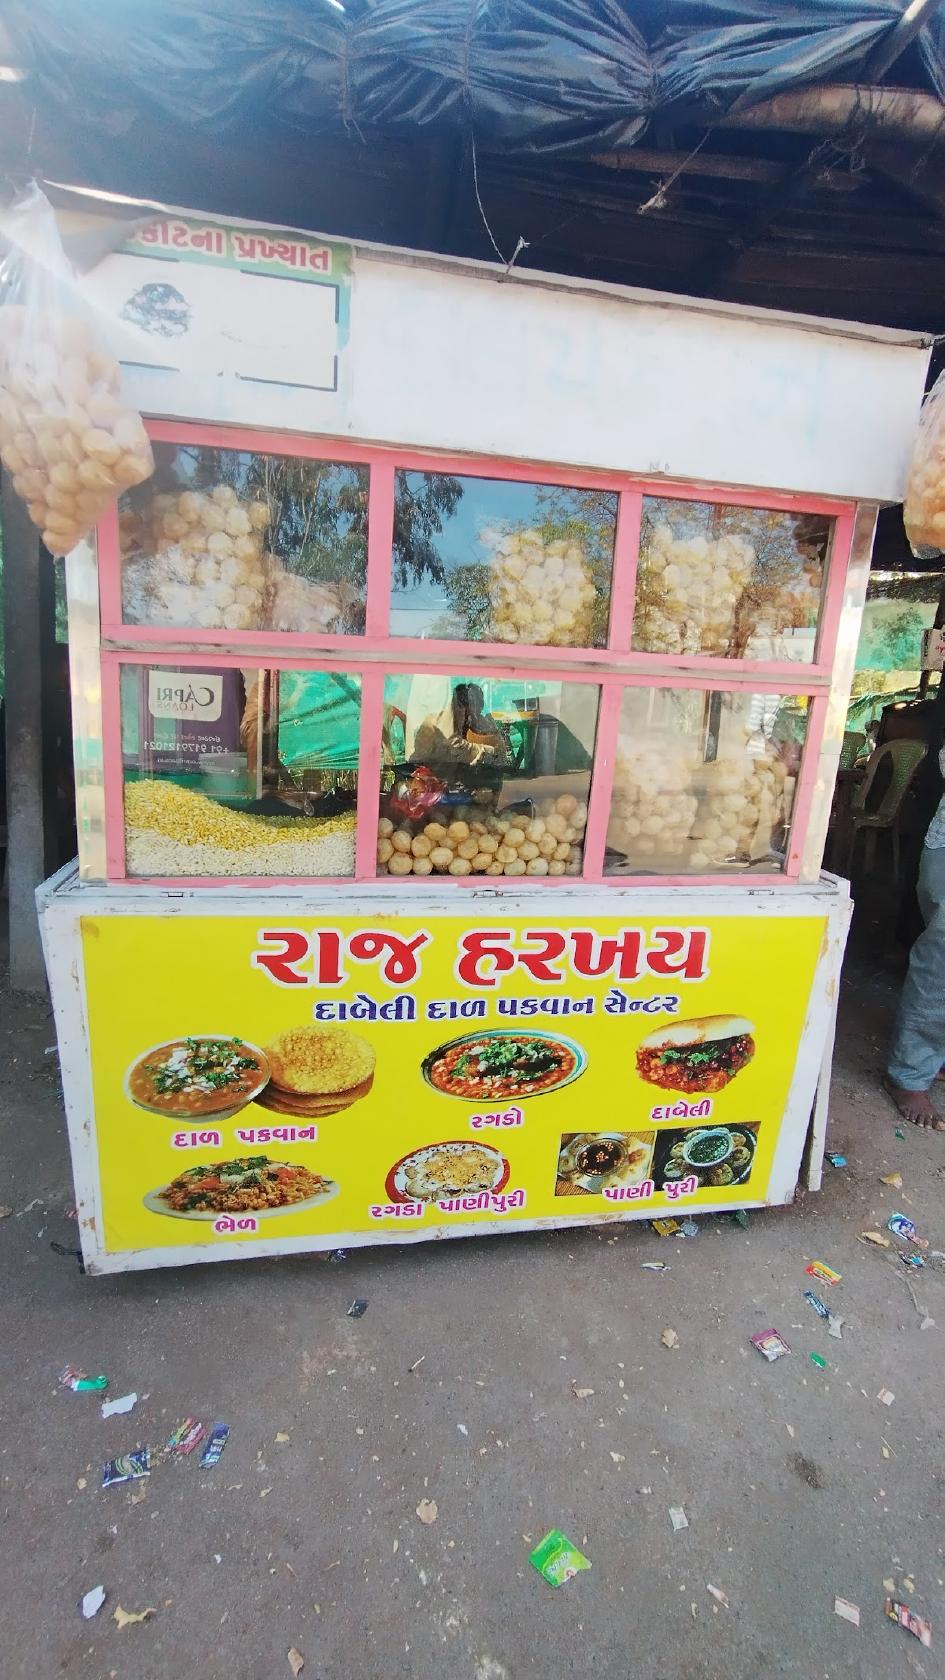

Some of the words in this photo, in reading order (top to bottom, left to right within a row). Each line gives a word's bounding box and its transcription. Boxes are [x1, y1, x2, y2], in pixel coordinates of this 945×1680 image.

[235, 235, 329, 271] પ્રખ્યાત
[256, 932, 429, 984] રાજ
[458, 931, 706, 986] હરખય
[315, 994, 416, 1021] દાબેલી
[427, 999, 485, 1020] દાળ
[498, 997, 595, 1016] પકવાન
[604, 989, 679, 1014] સેન્ટર
[471, 1108, 522, 1129] રગડો
[651, 1098, 711, 1120] દાબેલી
[174, 1130, 220, 1147] દાળ
[238, 1125, 316, 1144] પકવાન
[604, 1181, 652, 1200] પાણી
[665, 1177, 697, 1199] પુરી
[371, 1203, 423, 1217] રગડા
[439, 1189, 525, 1213] પાણીપુરી
[215, 1214, 257, 1233] ભેળ
